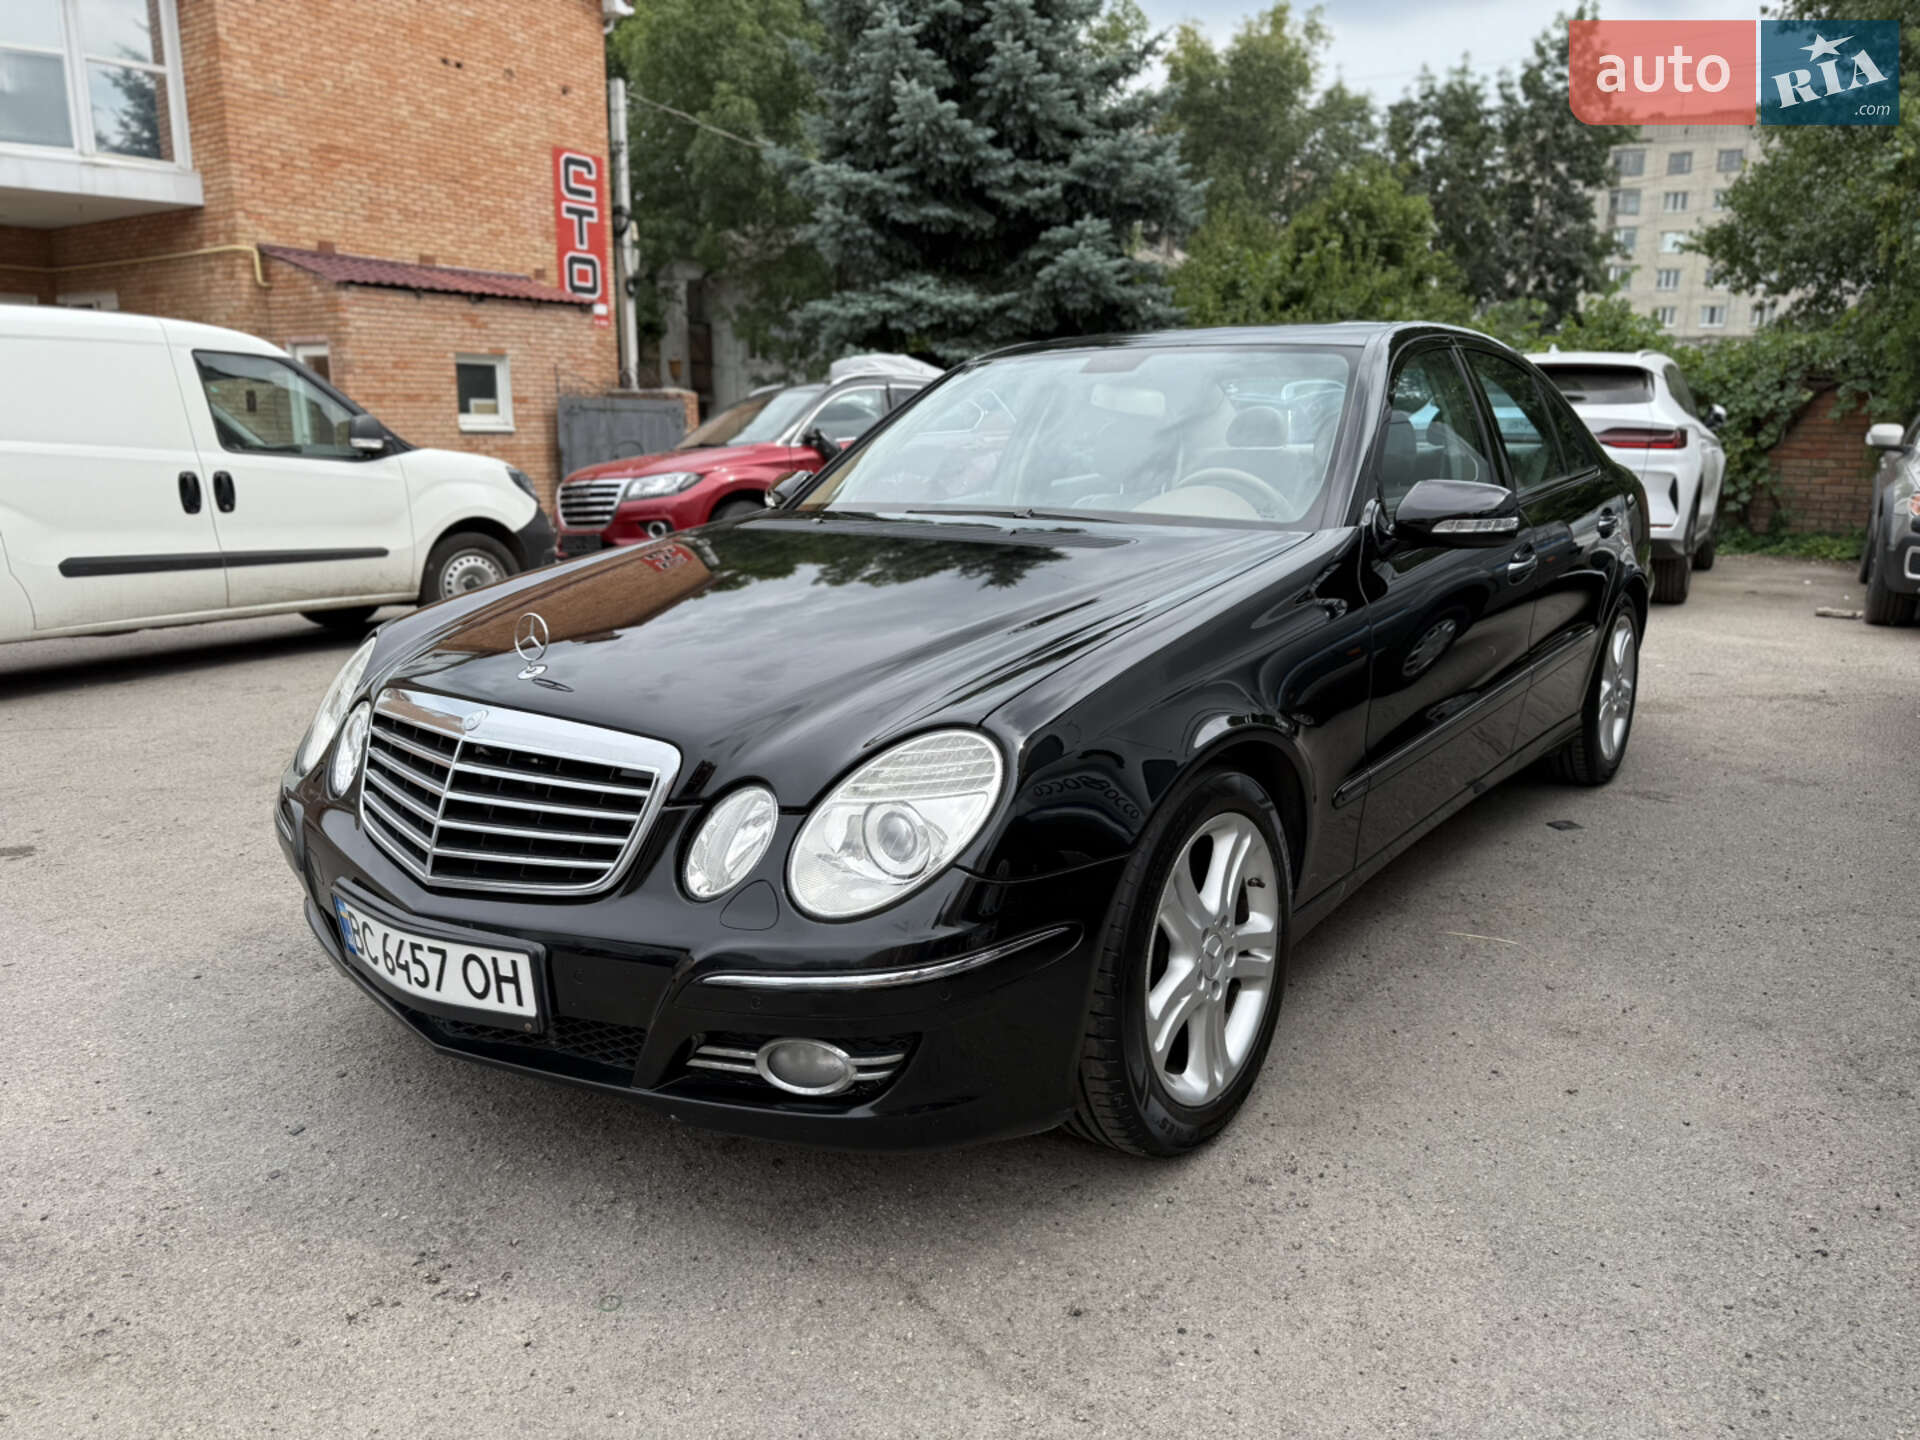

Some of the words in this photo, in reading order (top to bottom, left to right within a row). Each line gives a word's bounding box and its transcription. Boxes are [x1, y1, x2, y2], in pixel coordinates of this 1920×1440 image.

[348, 910, 379, 966] BC
[382, 932, 447, 992] 6457
[462, 953, 524, 1007] OH
